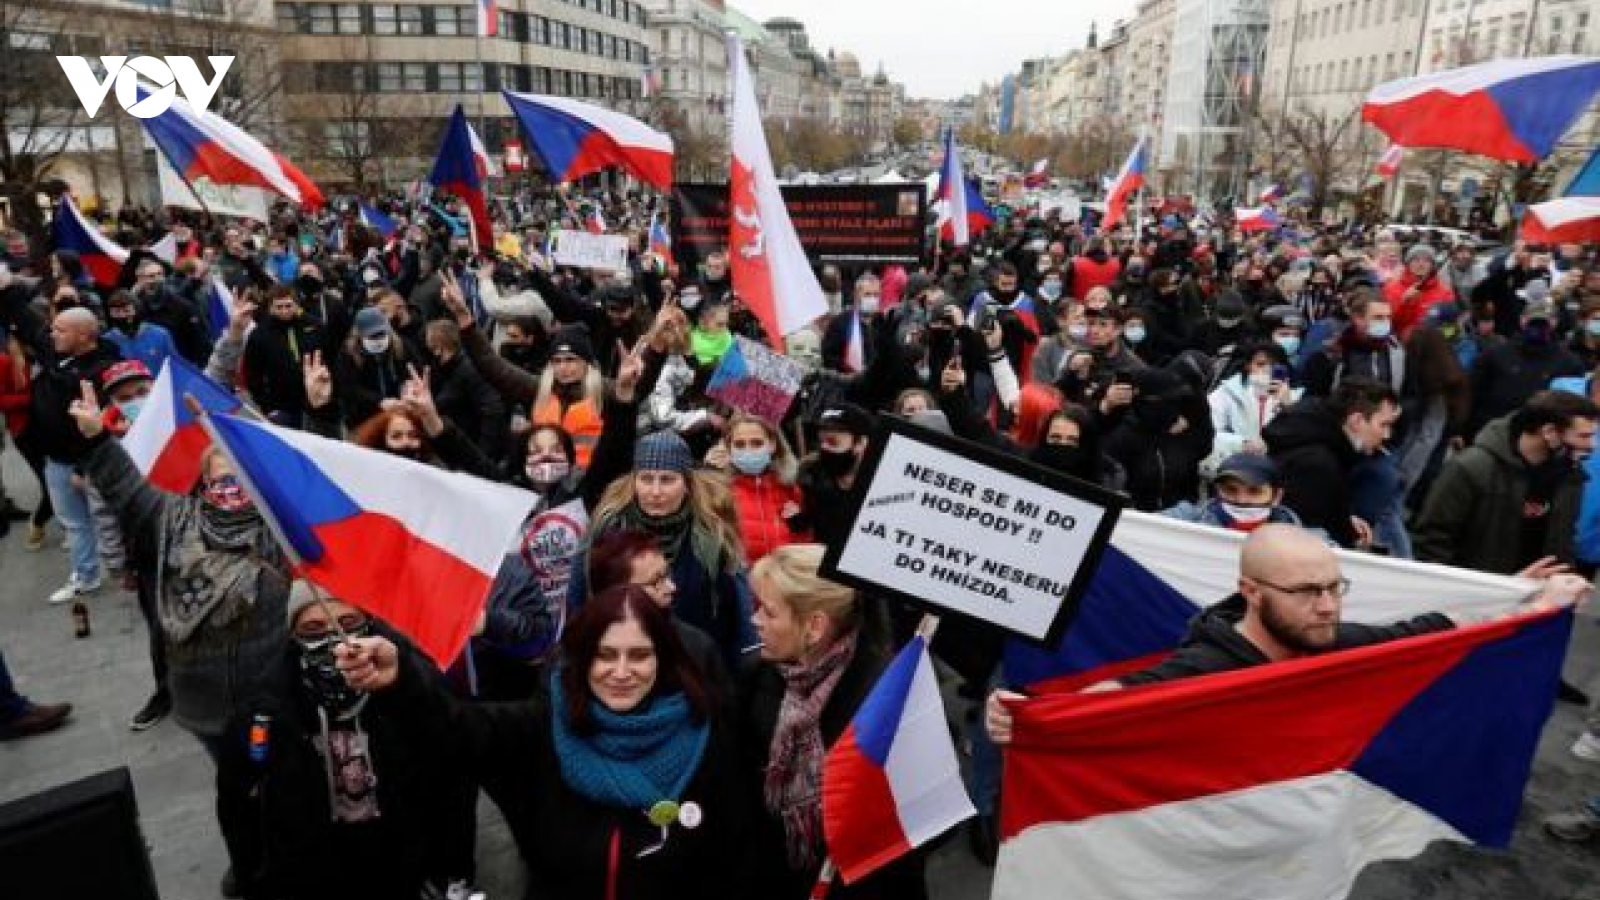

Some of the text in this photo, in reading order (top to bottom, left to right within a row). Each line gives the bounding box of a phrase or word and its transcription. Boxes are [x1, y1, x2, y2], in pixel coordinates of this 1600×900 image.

[904, 462, 1077, 531] NESER SE MI DO
[921, 491, 1044, 545] HOSPODY !!
[860, 520, 1070, 598] JA TI TAKY NESERU
[895, 552, 926, 574] DO
